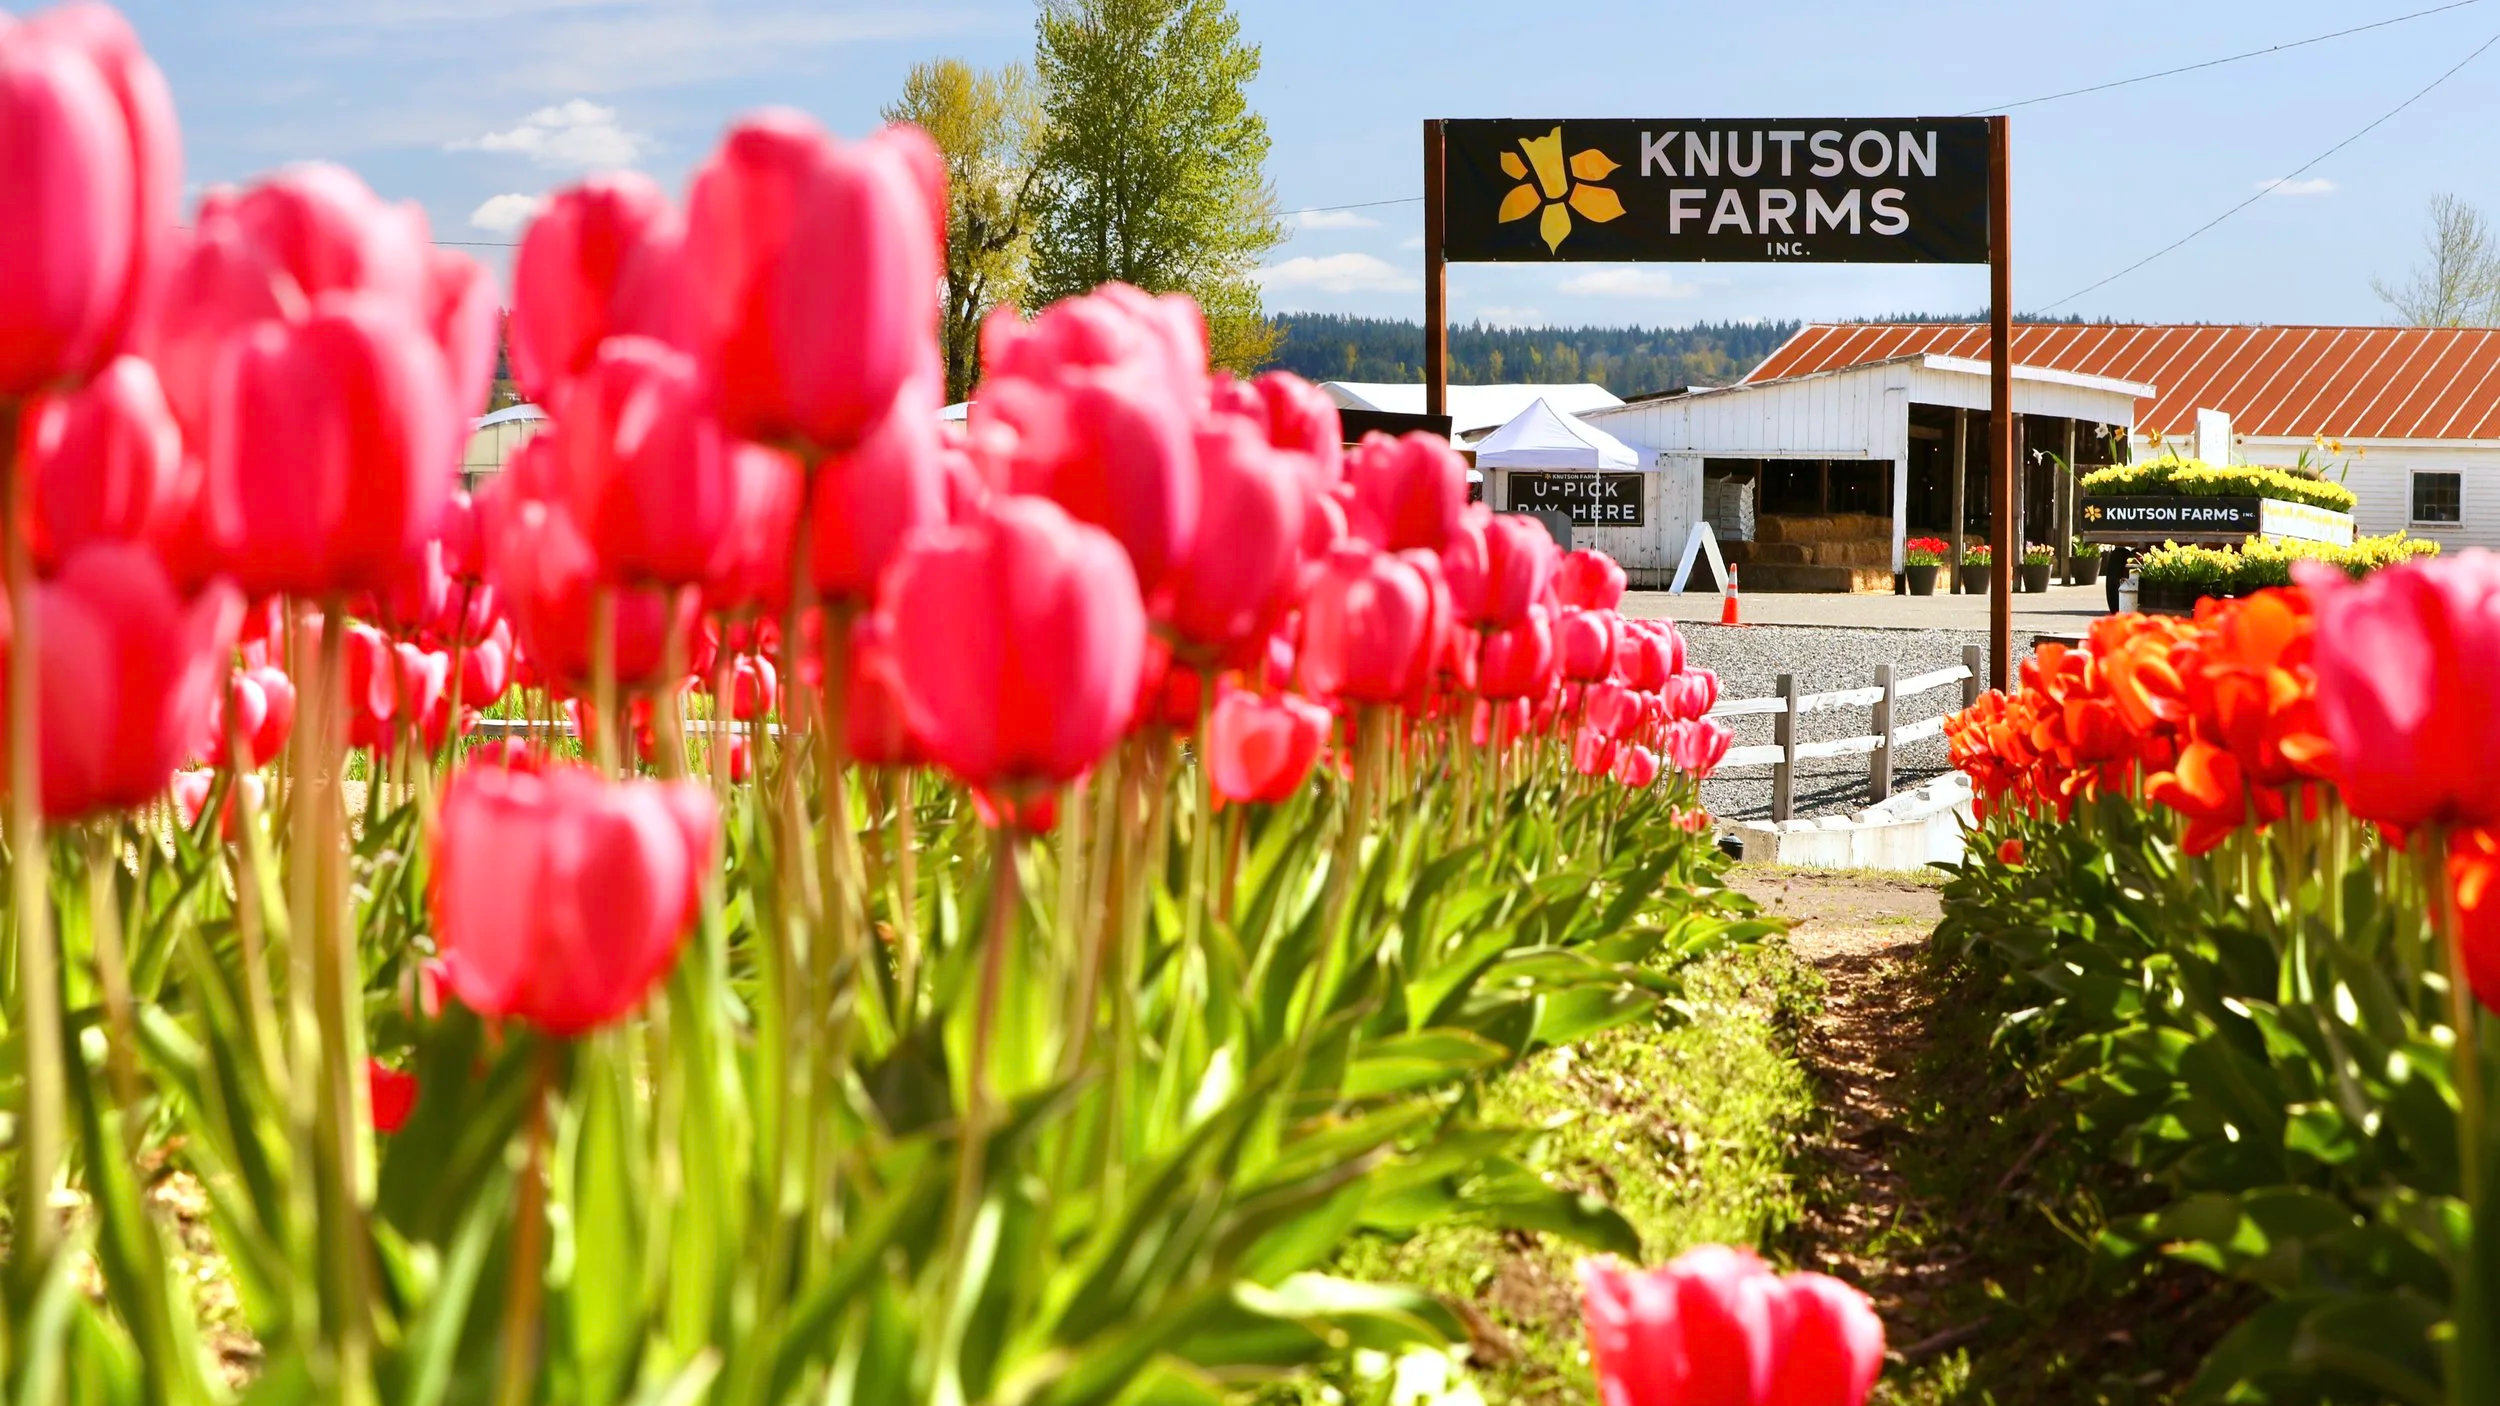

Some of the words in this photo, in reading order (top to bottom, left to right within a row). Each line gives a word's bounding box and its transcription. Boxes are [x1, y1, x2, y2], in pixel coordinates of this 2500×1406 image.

[1640, 130, 1938, 177] KNUTSON
[1669, 188, 1911, 235] FARMS
[1766, 241, 1811, 256] INC.
[1534, 482, 1618, 497] U-PICK
[1572, 504, 1635, 519] HERE
[2106, 507, 2177, 521] KNUTSON
[2181, 507, 2239, 521] FARMS
